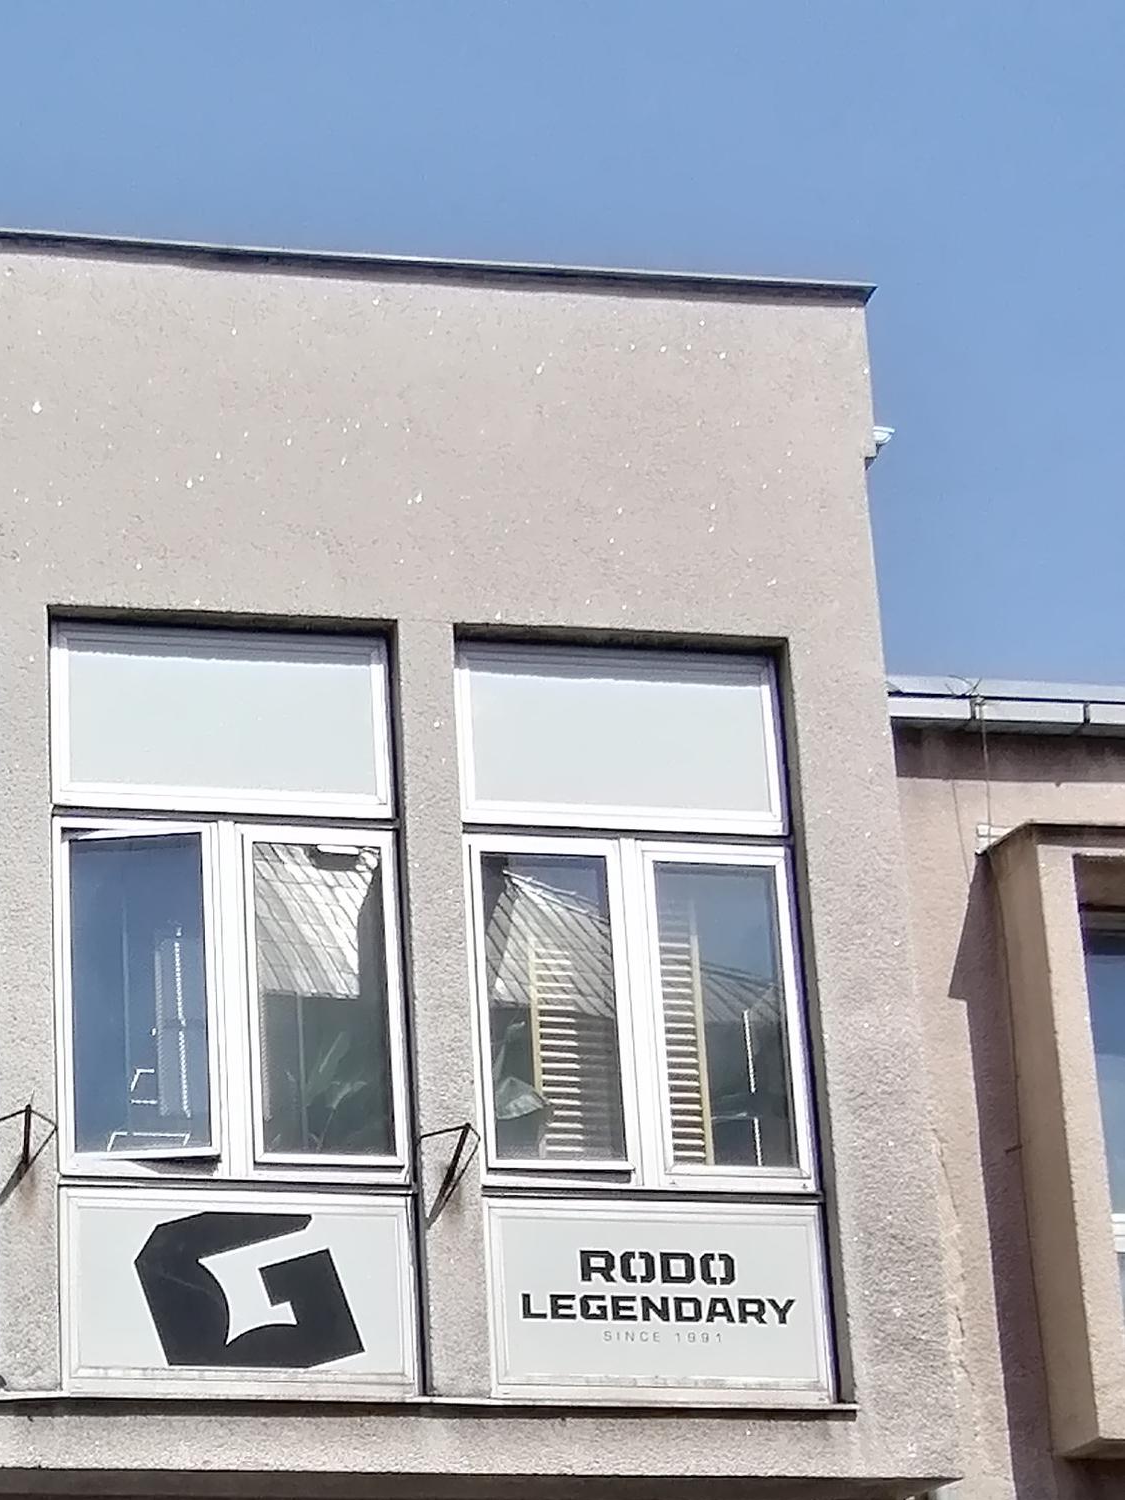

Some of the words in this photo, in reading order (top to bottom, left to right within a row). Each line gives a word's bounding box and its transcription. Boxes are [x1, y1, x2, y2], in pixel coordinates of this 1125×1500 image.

[579, 1250, 736, 1285] RODO
[521, 1293, 796, 1325] LEGENDARY
[603, 1330, 661, 1343] SINCE
[675, 1332, 723, 1344] 1991
